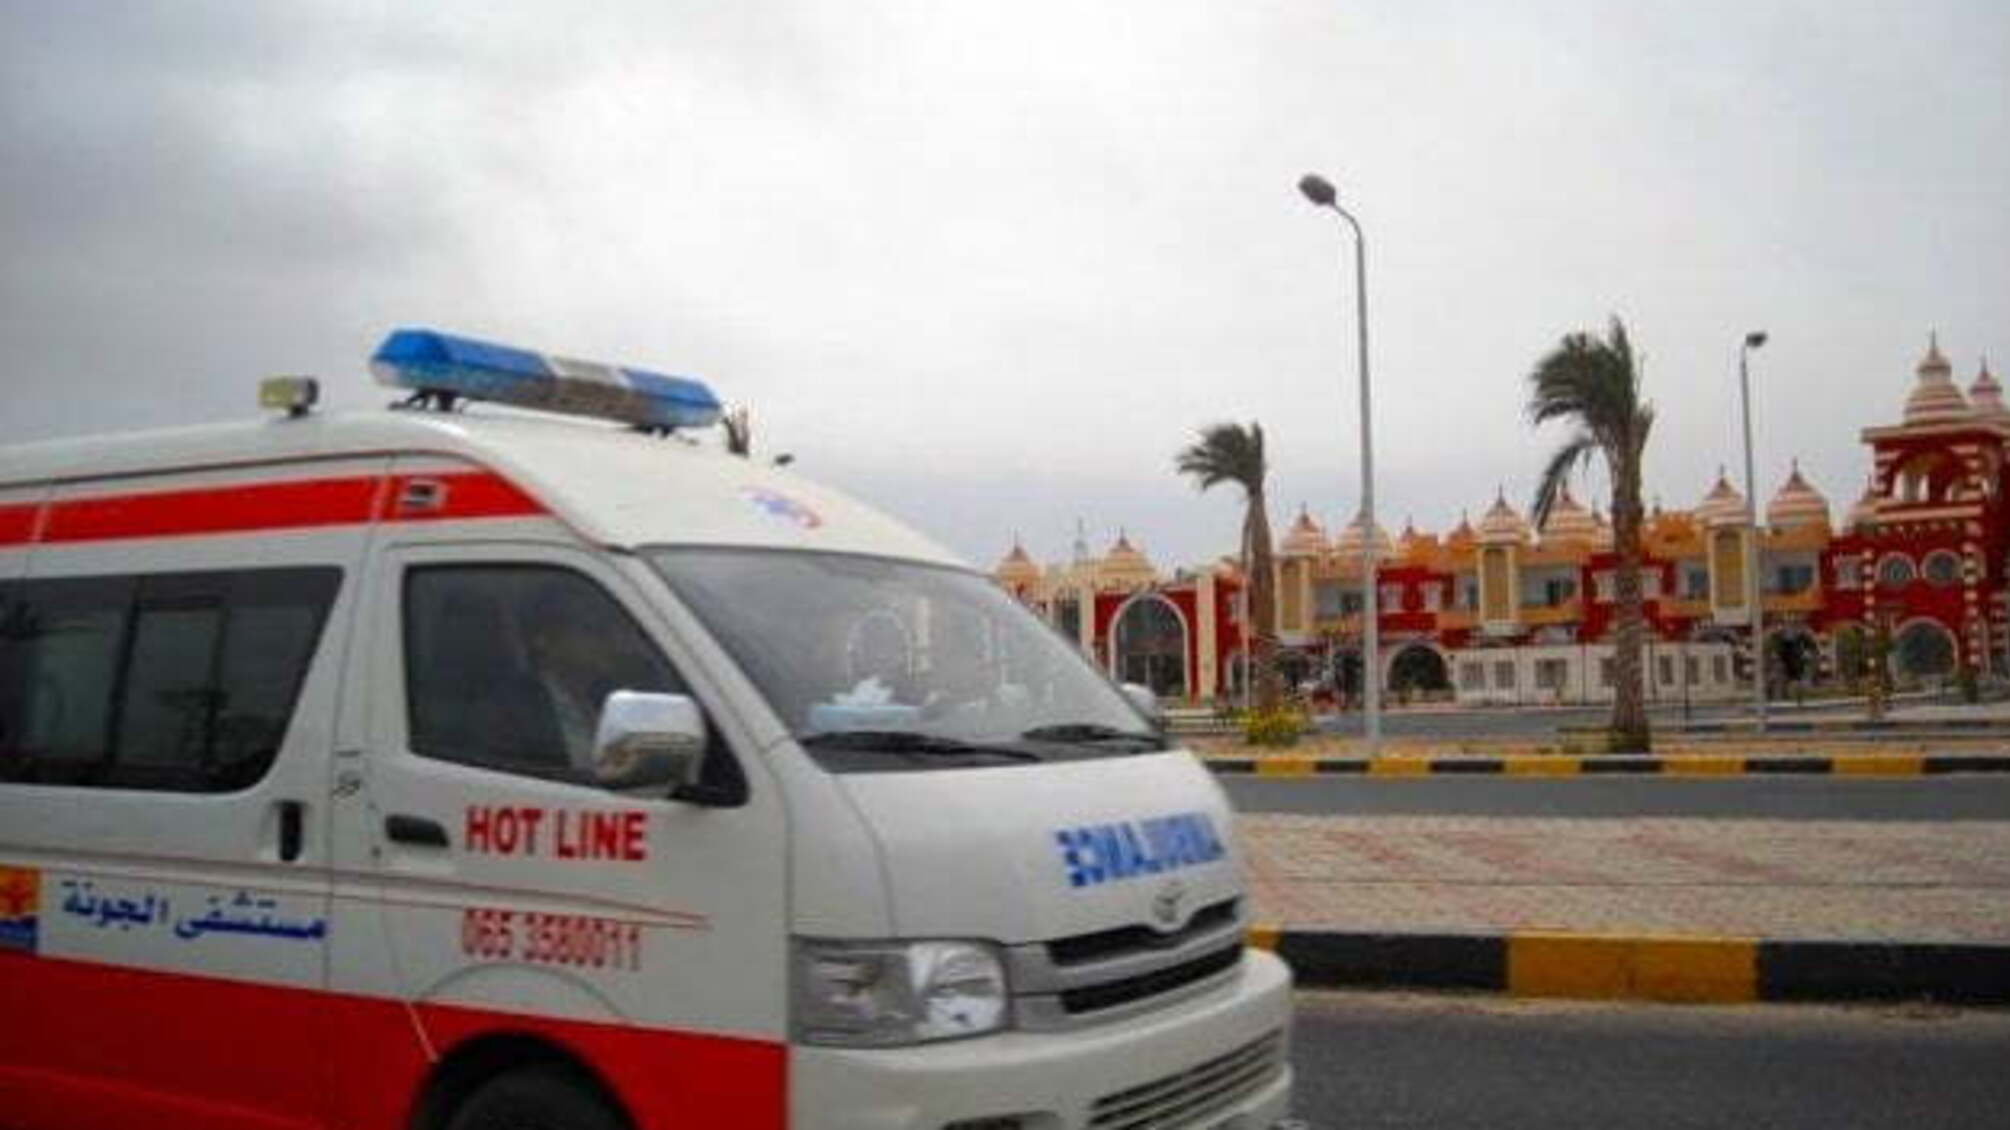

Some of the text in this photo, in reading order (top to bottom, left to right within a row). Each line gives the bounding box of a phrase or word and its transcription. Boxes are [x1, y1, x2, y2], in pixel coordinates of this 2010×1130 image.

[465, 806, 646, 862] HOT LINE
[61, 880, 326, 940] مستشفى الجونة
[463, 906, 514, 958] 065
